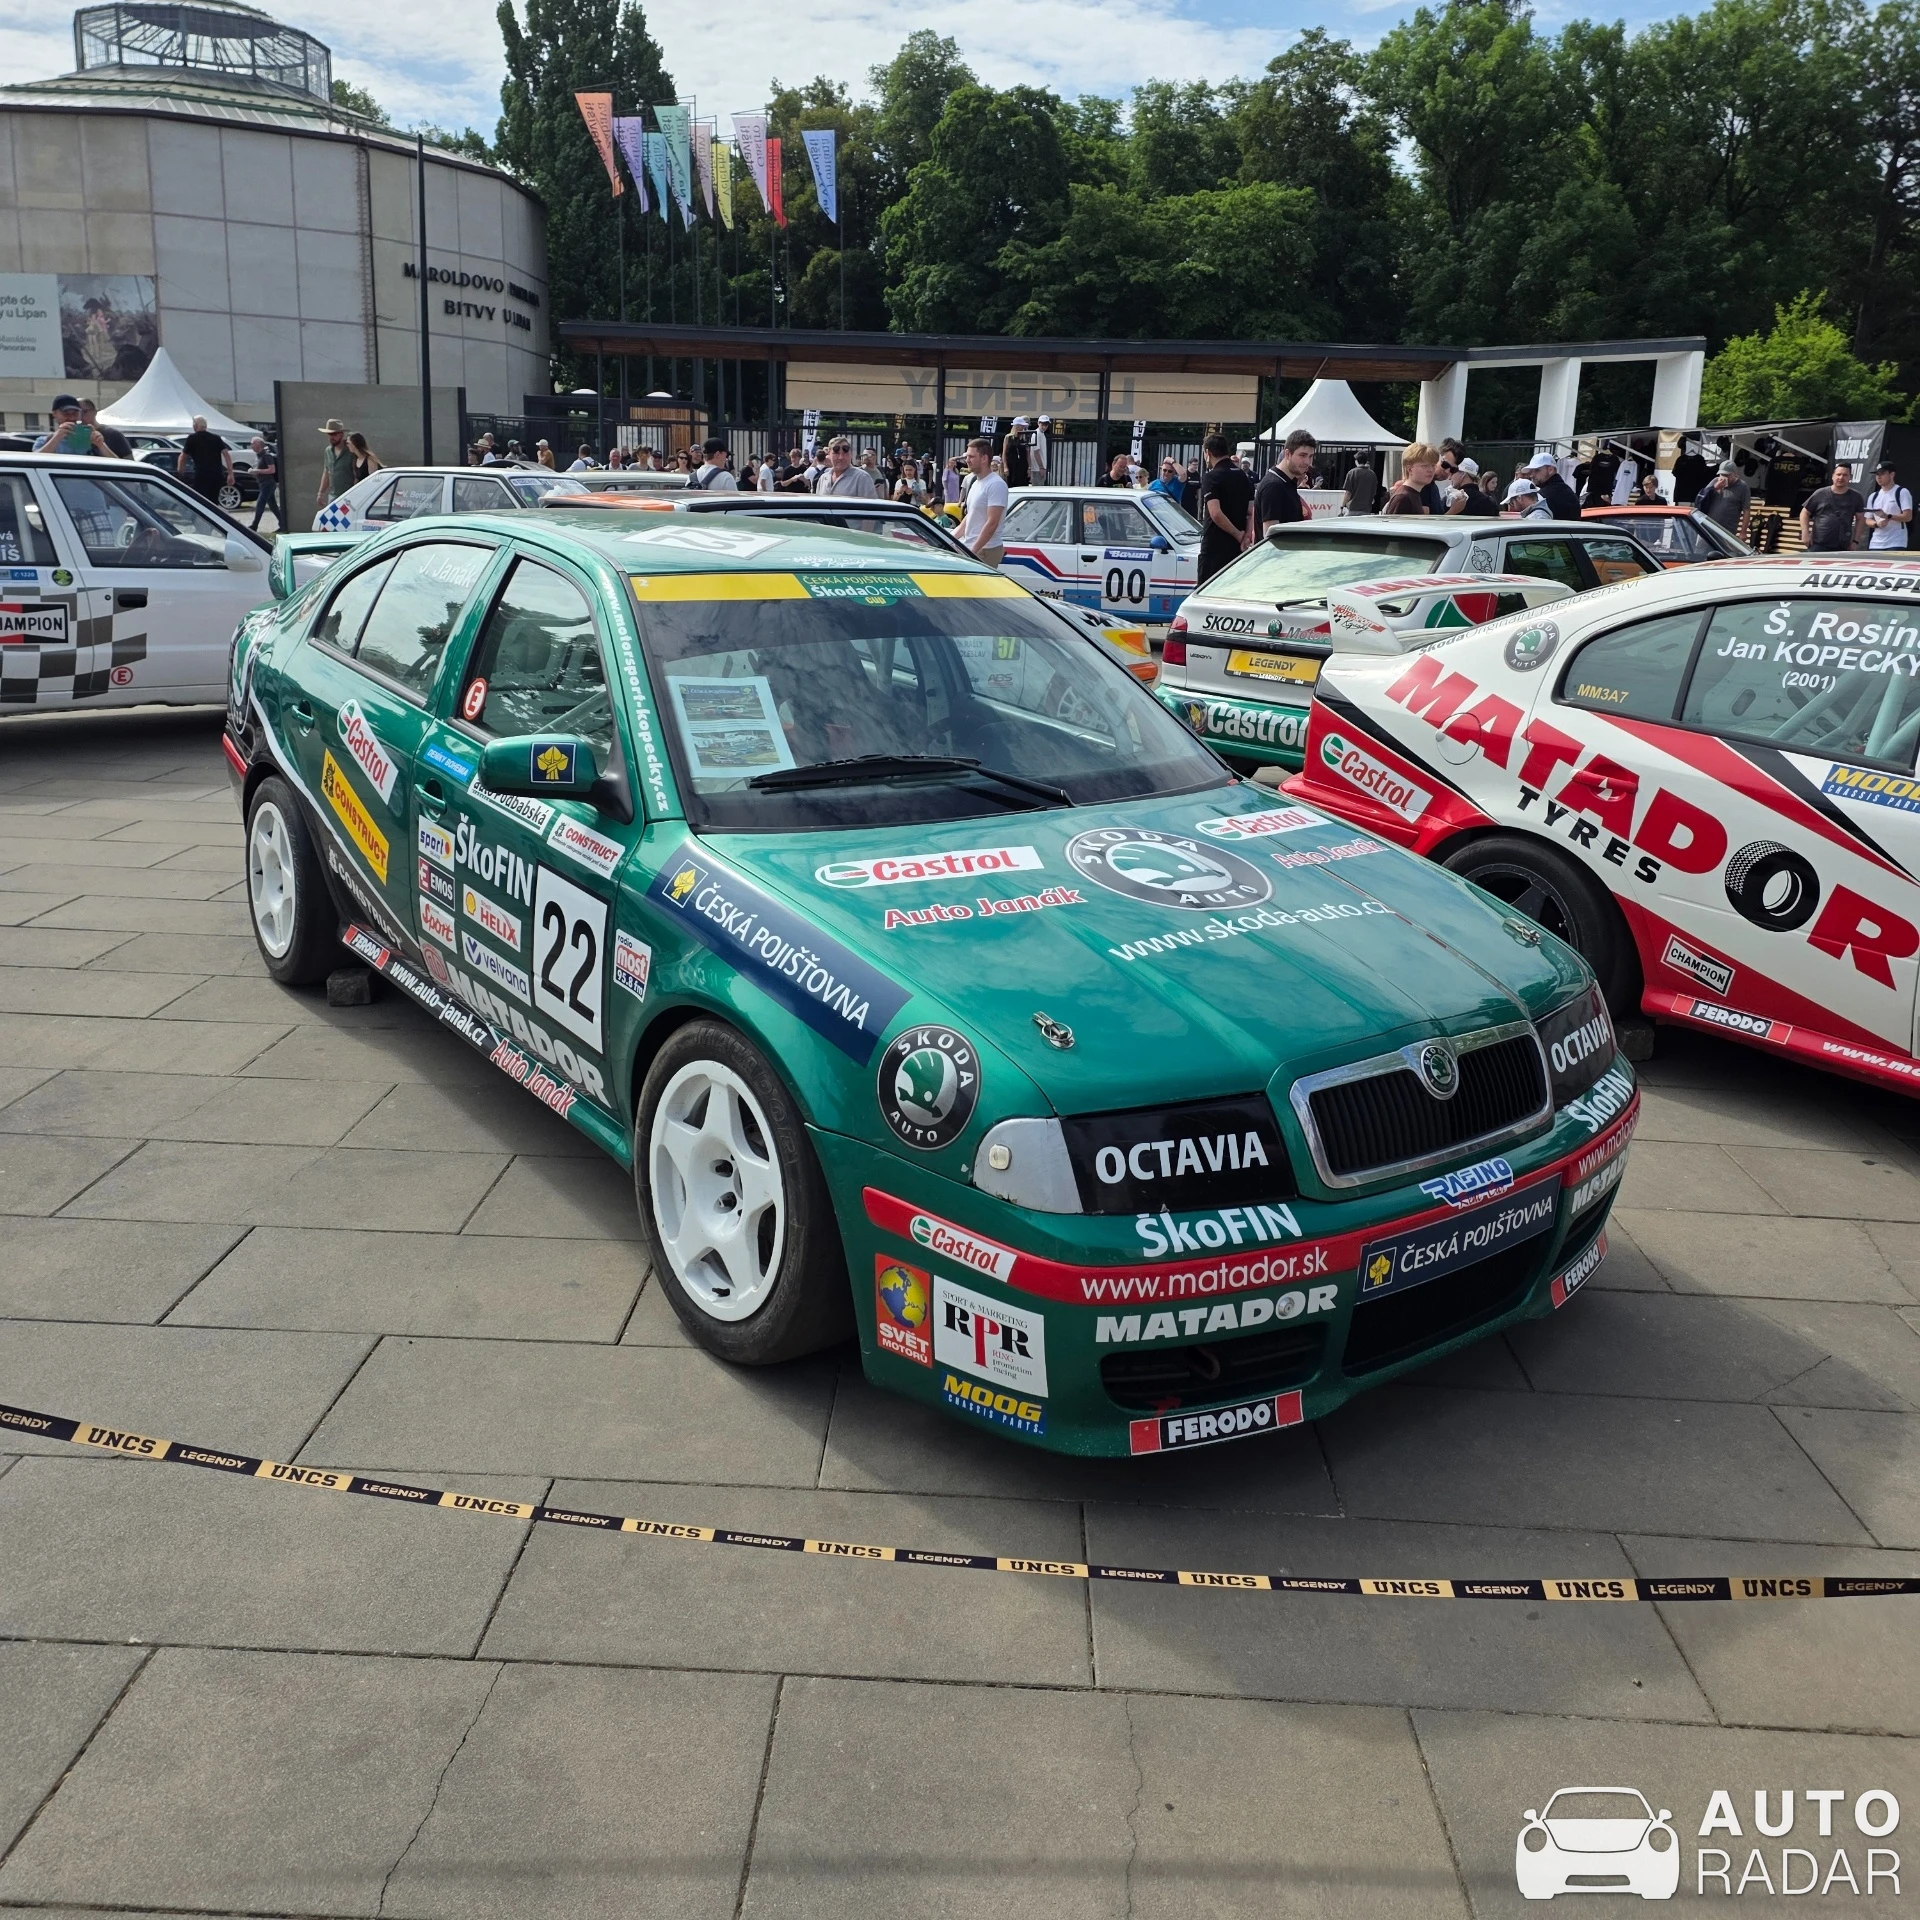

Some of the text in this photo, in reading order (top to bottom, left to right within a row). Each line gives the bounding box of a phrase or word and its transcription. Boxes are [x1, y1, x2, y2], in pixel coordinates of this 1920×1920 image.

[16, 308, 47, 320] Lipan
[20, 295, 35, 305] do
[444, 299, 496, 320] BITVY
[502, 308, 512, 324] U
[419, 554, 476, 588] J. Janák
[1109, 550, 1149, 559] Barum
[803, 575, 911, 585] ČESKÁ POJIŠŤOVNA
[1105, 567, 1146, 604] 00
[864, 596, 887, 605] cup
[0, 616, 62, 631] AMPION
[1202, 612, 1255, 634] ŠKODA
[1516, 621, 1556, 641] SKODA
[1763, 601, 1920, 650] Š. Rosin
[998, 636, 1016, 659] 57
[1248, 657, 1296, 672] LEGENDY
[1510, 658, 1537, 669] AUTO
[1717, 636, 1767, 660] Jan
[468, 685, 483, 712] E
[601, 575, 669, 812] www.motorsport-kopecky.cz
[1577, 683, 1630, 704] MM3A7
[1782, 671, 1837, 694] (2001)
[347, 718, 389, 790] Castrol
[1340, 750, 1416, 812] Castrol
[1827, 785, 1920, 812] CHASSIS PART
[335, 780, 387, 863] CONSTRUCT
[1226, 810, 1316, 836] Castrol
[1384, 654, 1920, 992] MATADOR
[1517, 785, 1662, 884] TYRES
[420, 830, 444, 854] sport
[455, 812, 534, 907] ŠkoFIN
[565, 827, 619, 864] CONSTRUCT
[1075, 830, 1200, 865] SKODA
[1271, 838, 1390, 869] Auto Janák
[872, 850, 1020, 882] Castrol
[430, 873, 453, 901] EMOS
[1179, 884, 1259, 905] AUTO
[337, 863, 403, 950] CONSTRUCT
[884, 886, 1088, 929] Auto Janák
[480, 906, 518, 947] HELIX
[617, 934, 633, 949] radio
[1108, 898, 1395, 962] www.skoda-auto.cz
[353, 934, 381, 964] FERODO
[541, 901, 597, 1024] 22
[617, 947, 647, 980] most
[695, 881, 870, 1031] ČESKÁ POJIŠŤOVNA
[1669, 947, 1727, 987] CHAMPION
[483, 952, 529, 996] velvana
[617, 969, 643, 996] 95.8 fm
[390, 961, 488, 1047] www.auto-janak.cz
[1694, 1003, 1772, 1036] FERODO
[446, 961, 612, 1108] MATADOR
[1549, 1013, 1611, 1074] OCTAVIA
[896, 1030, 976, 1089] SKODA
[490, 1038, 578, 1119] Auto Janák
[1566, 1067, 1634, 1134] ŠkoFIN
[889, 1110, 938, 1143] AUTO
[1095, 1131, 1269, 1185] OCTAVIA
[1135, 1203, 1303, 1258] ŠkoFIN
[1400, 1234, 1459, 1274] ČESKÁ
[1463, 1195, 1553, 1253] POJIŠŤOVNA
[932, 1226, 1001, 1275] Castrol
[1565, 1243, 1600, 1292] FERODO
[1080, 1247, 1329, 1300] www.matador.sk
[942, 1290, 1029, 1329] SPORT & MARKETING
[1095, 1284, 1339, 1343] MATADOR
[879, 1321, 931, 1354] SVĚT
[882, 1337, 930, 1365] MOTORŮ
[943, 1300, 1034, 1369] RPR
[992, 1349, 1015, 1363] RING
[992, 1358, 1033, 1377] promotion
[993, 1366, 1018, 1381] racing
[943, 1374, 1043, 1423] MOOG
[948, 1394, 1040, 1434] CHASSIS PARTS
[1167, 1402, 1272, 1444] FERODO
[0, 1411, 1905, 1599] GENDY UNCS LEGENDY UNCS LEGENDY UNCS LEGENDY UNCS LEGENDY UNCS LEGENDY UNCS LEGENDY UNCS LEGENDY UNCS LEGENDY UNCS LEGENDY UNCS LEGENDY
